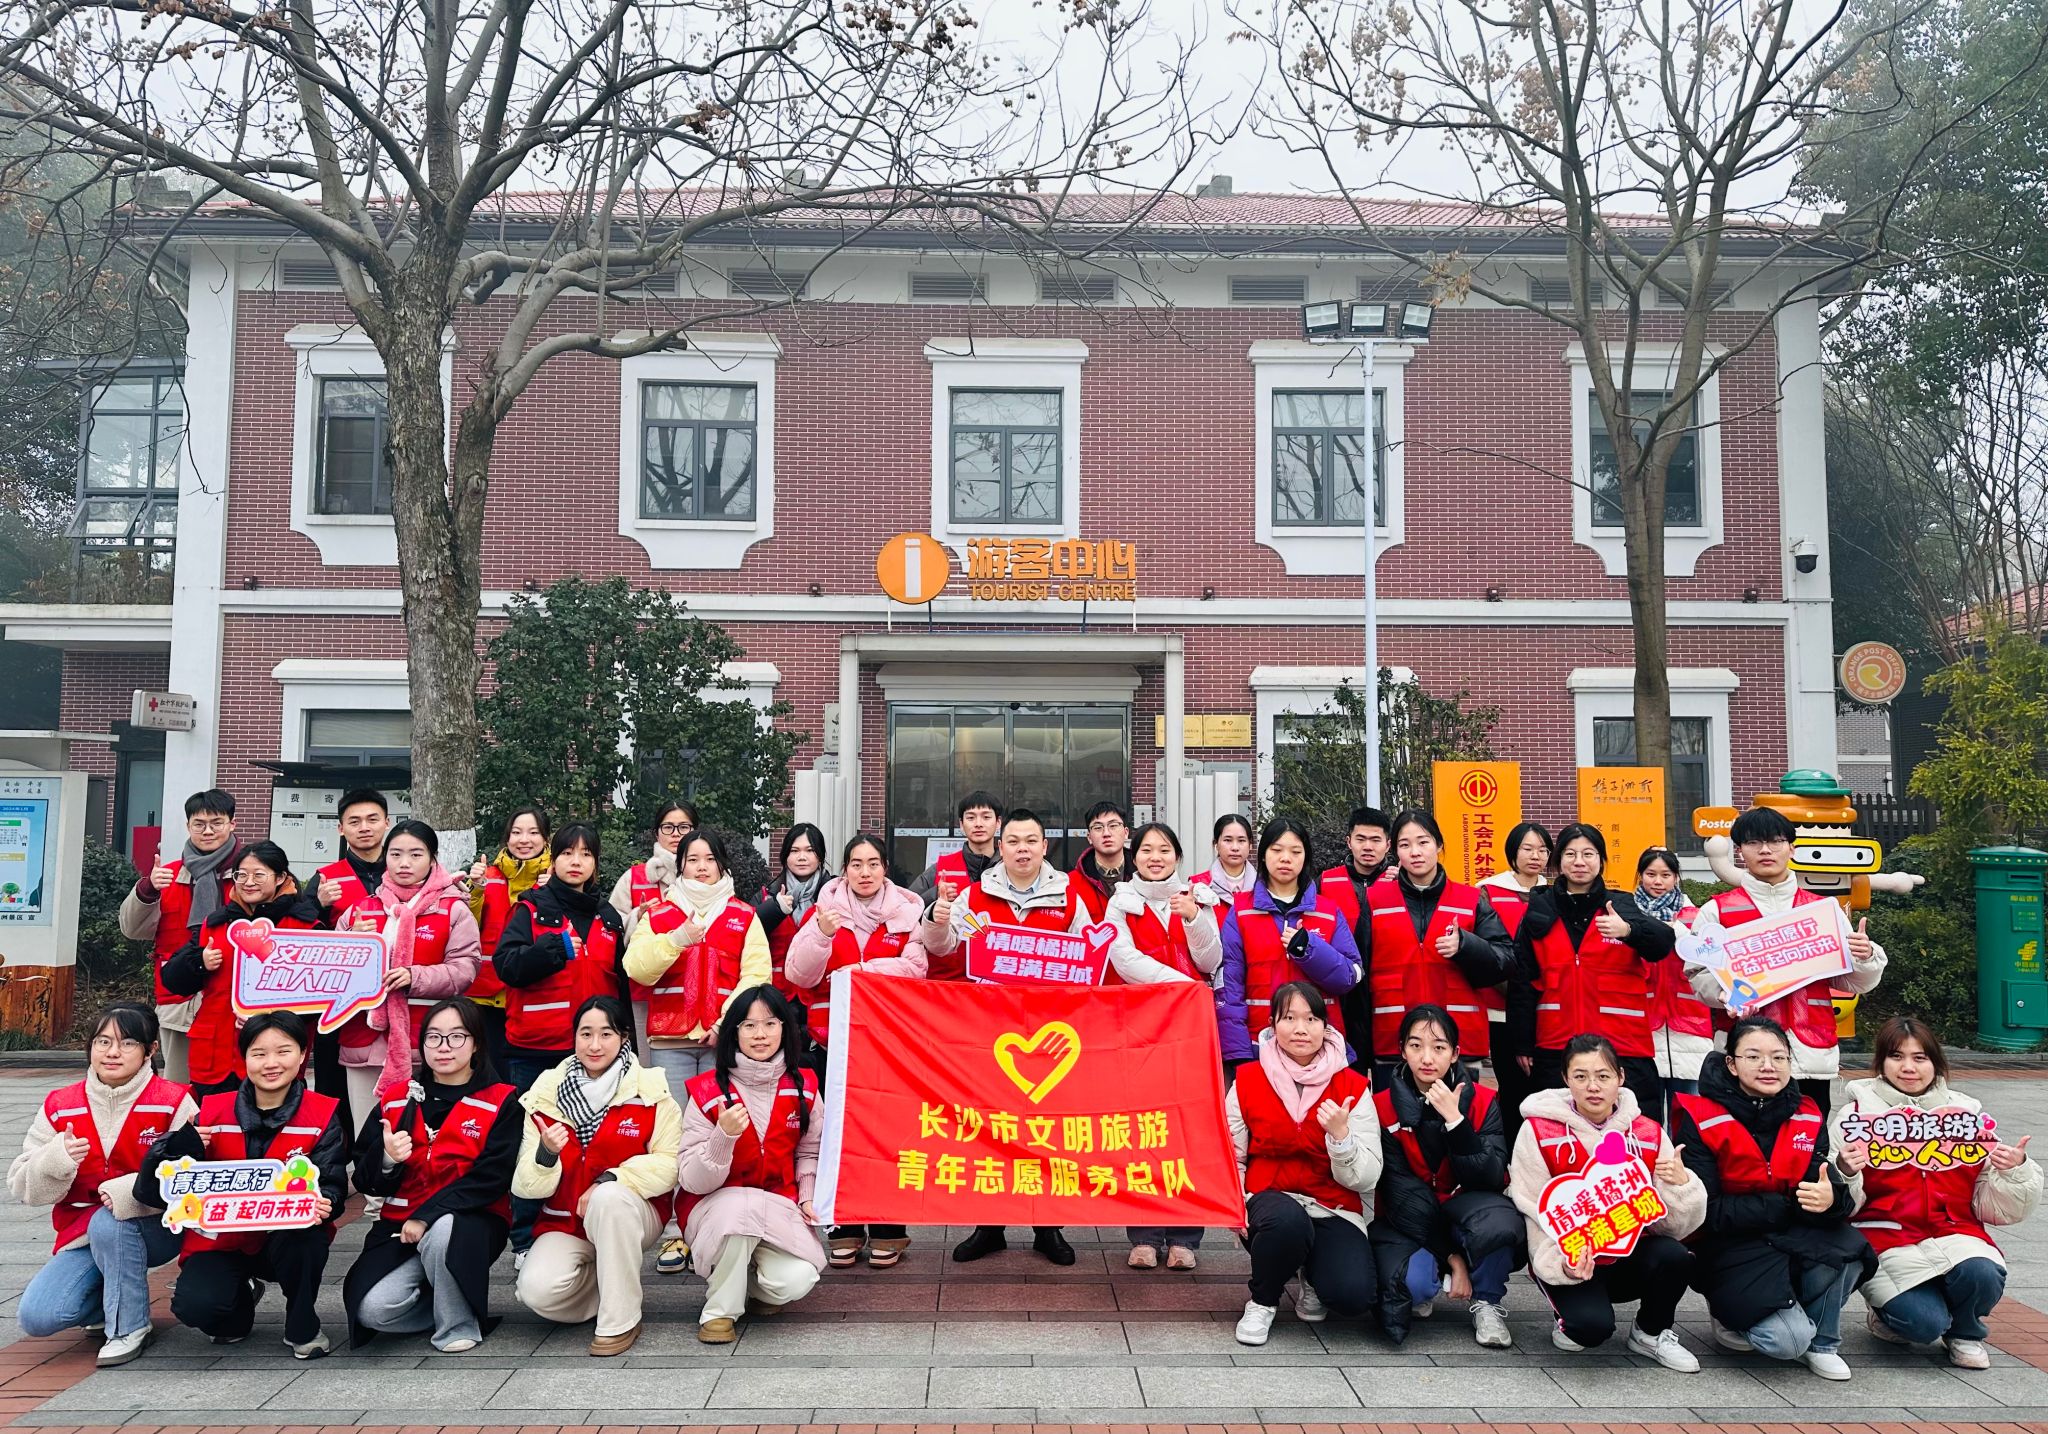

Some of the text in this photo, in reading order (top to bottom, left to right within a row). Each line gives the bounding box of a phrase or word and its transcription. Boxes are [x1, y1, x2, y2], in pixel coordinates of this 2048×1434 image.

[967, 537, 1136, 580] 游客中心
[969, 583, 1137, 601] TOURIST CENTRE
[1848, 647, 1901, 682] ORANGE POST OFFICE
[290, 793, 300, 803] 费
[324, 794, 334, 804] 寄
[314, 840, 324, 850] 免
[1473, 813, 1496, 880] 工会户外劳
[1463, 853, 1471, 882] OUTDOOR
[985, 930, 1087, 962] 情暖橘洲
[1724, 918, 1817, 960] 青春志愿行
[271, 944, 373, 968] 文明旅游
[992, 954, 1093, 986] 爱满星城
[256, 966, 352, 993] 沁人心
[918, 1101, 1169, 1154] 长沙市文明旅游
[1841, 1112, 1978, 1143] 文明旅游
[1867, 1139, 1989, 1167] 沁人心
[172, 1168, 273, 1195] 青春志愿行
[897, 1149, 1196, 1199] 青年志愿服务总队
[1548, 1162, 1648, 1236] 情暖橘洲
[1563, 1189, 1664, 1263] 爱满星城
